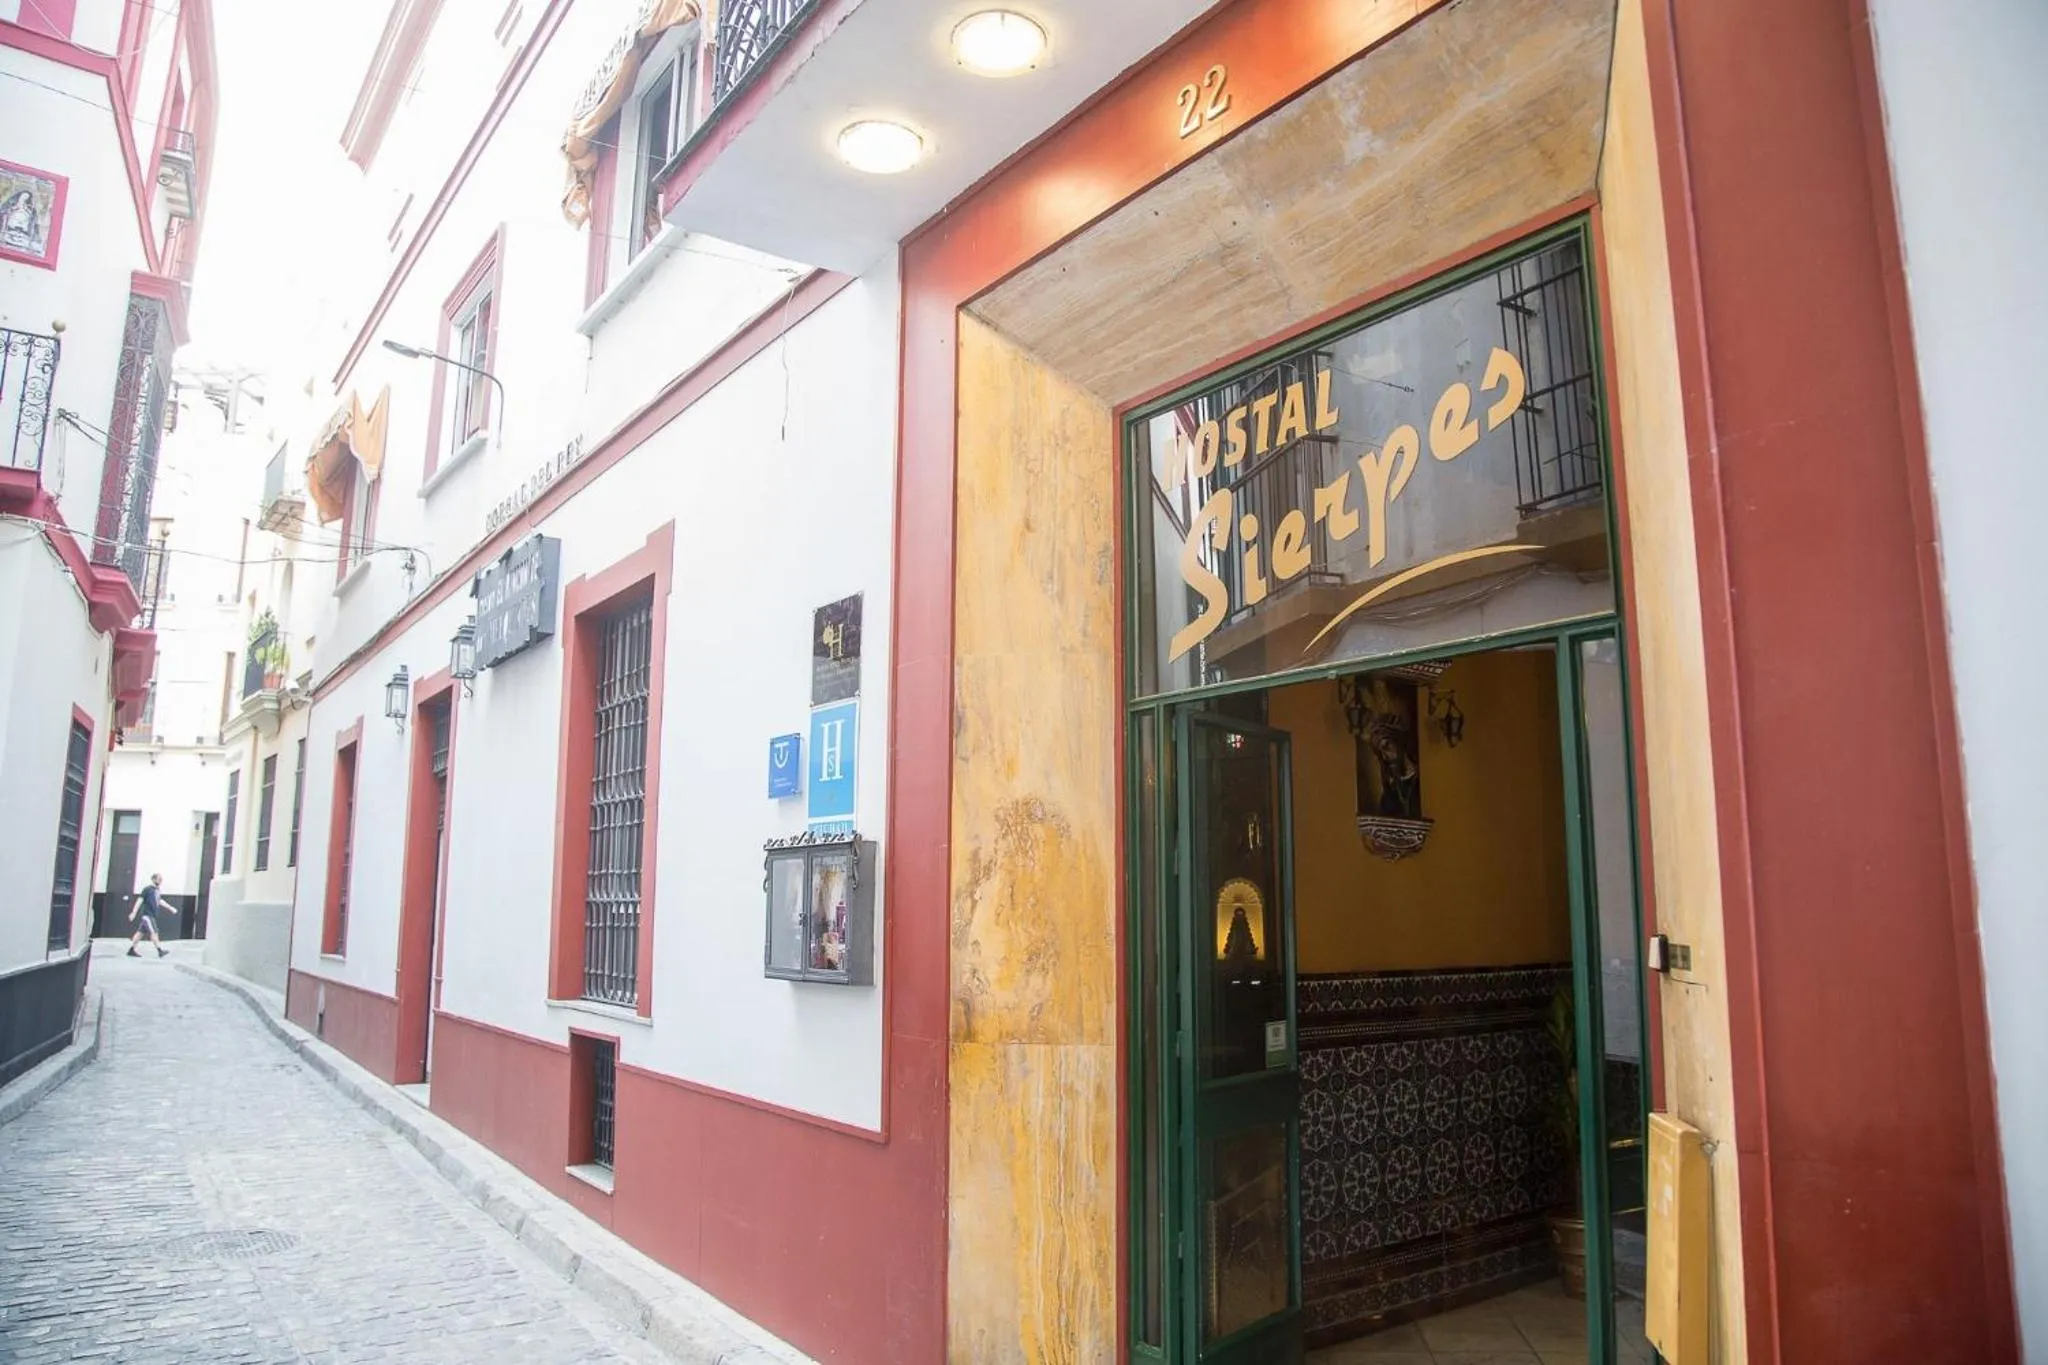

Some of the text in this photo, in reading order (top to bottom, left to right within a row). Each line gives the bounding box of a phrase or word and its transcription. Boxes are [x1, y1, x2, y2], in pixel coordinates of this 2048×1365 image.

[1177, 64, 1231, 139] 22
[1162, 369, 1339, 492] HOSTAL
[1168, 346, 1526, 664] Sierpes
